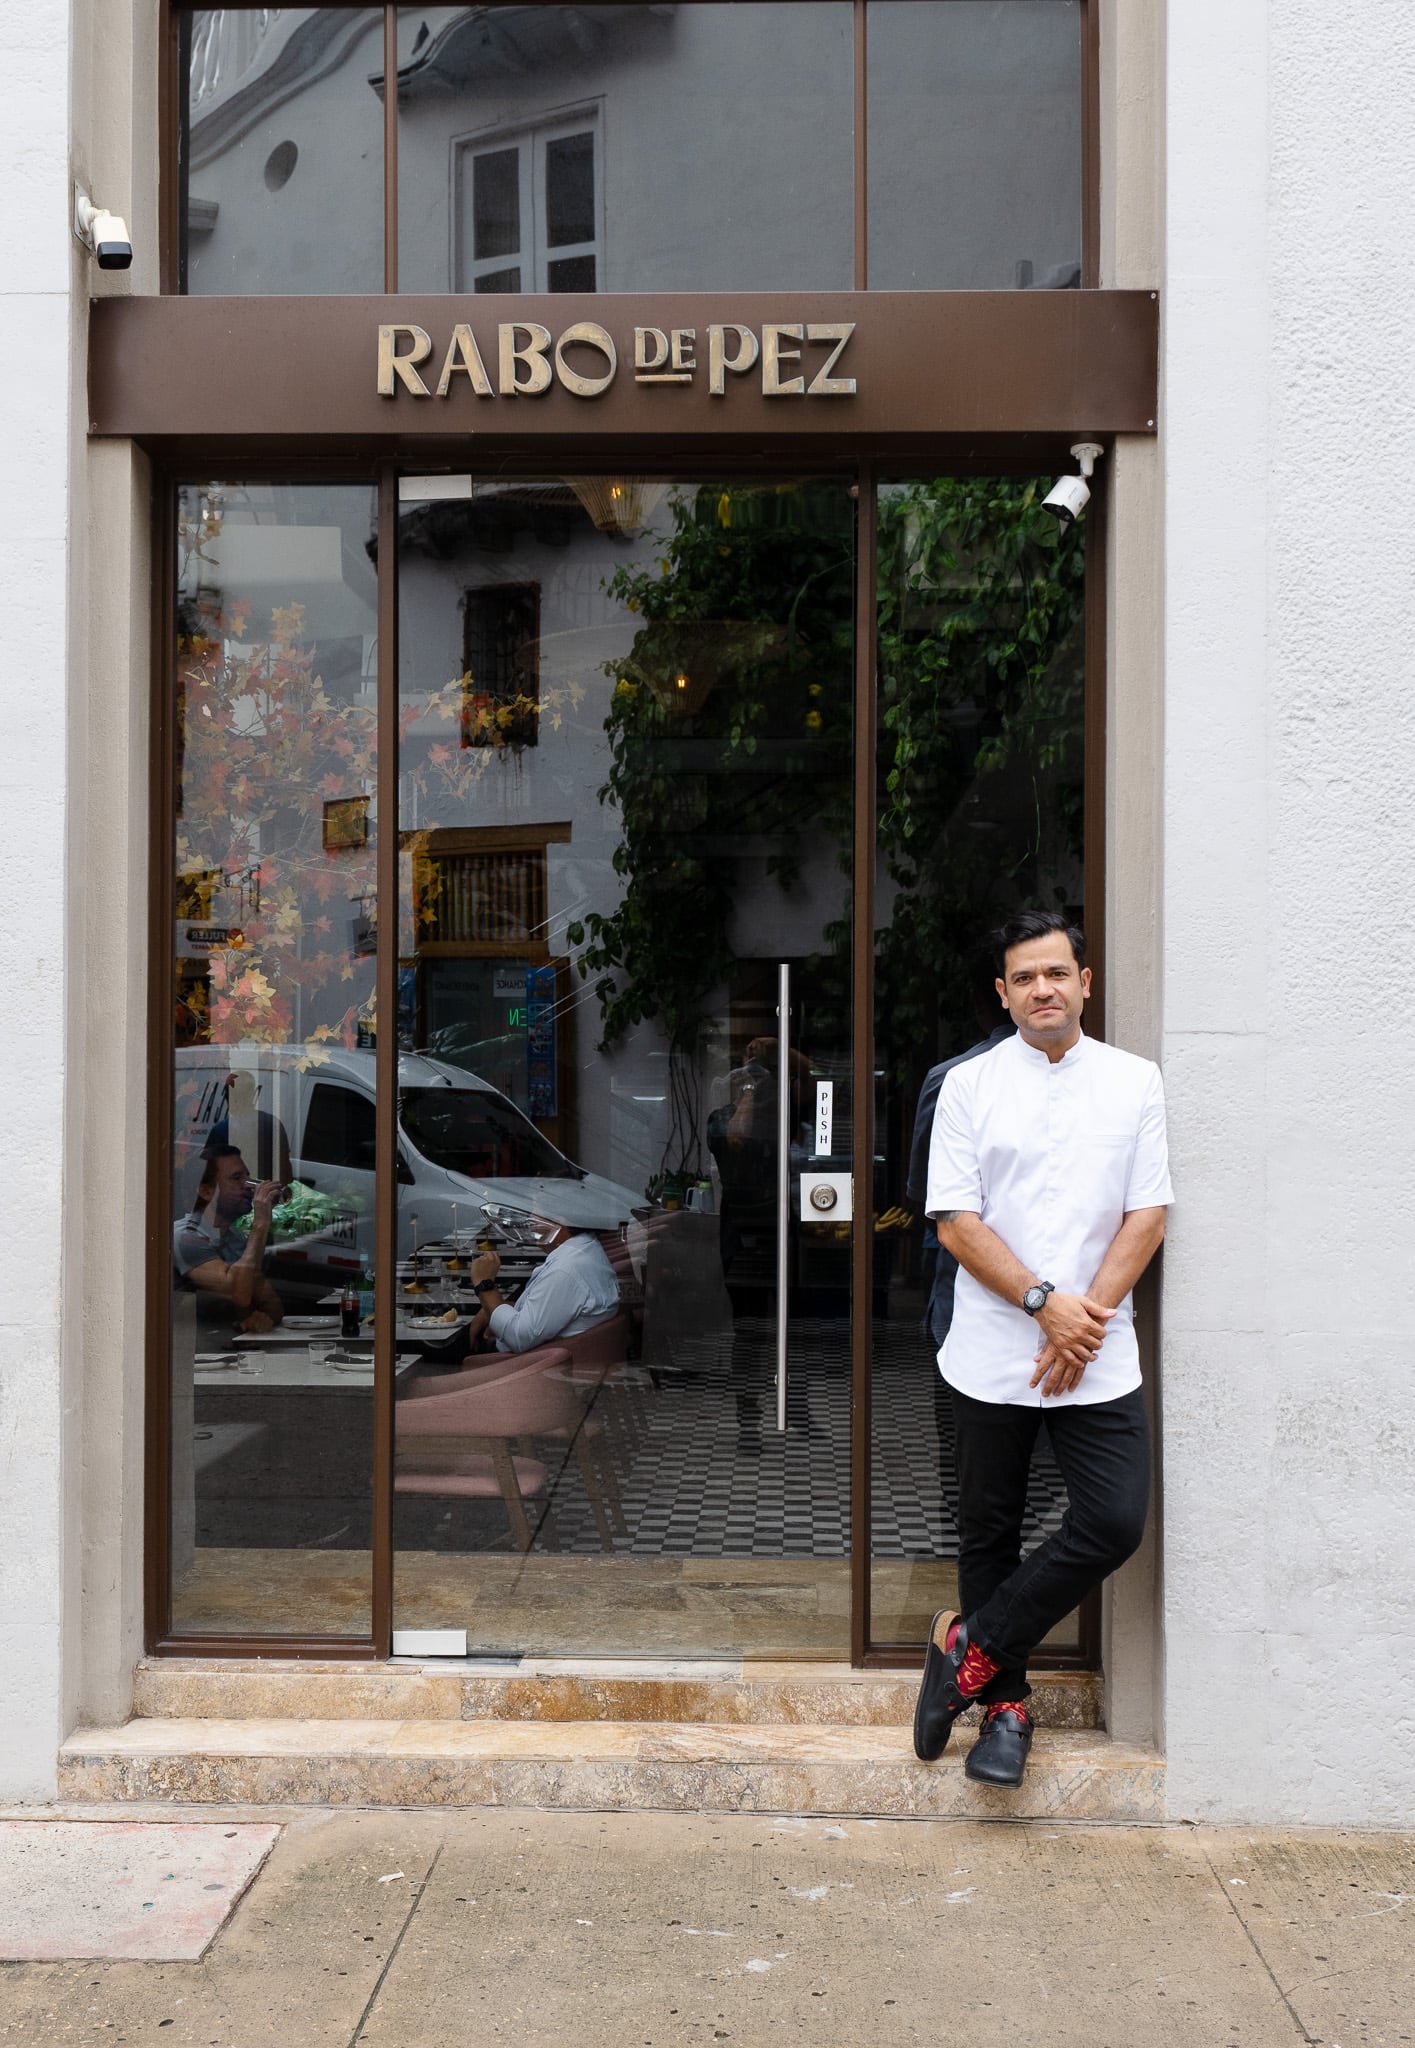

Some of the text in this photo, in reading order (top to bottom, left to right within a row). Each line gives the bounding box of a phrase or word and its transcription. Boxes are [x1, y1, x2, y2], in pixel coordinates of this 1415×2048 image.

[378, 322, 856, 396] RABO DE PEZ
[820, 1092, 829, 1144] PUSH
